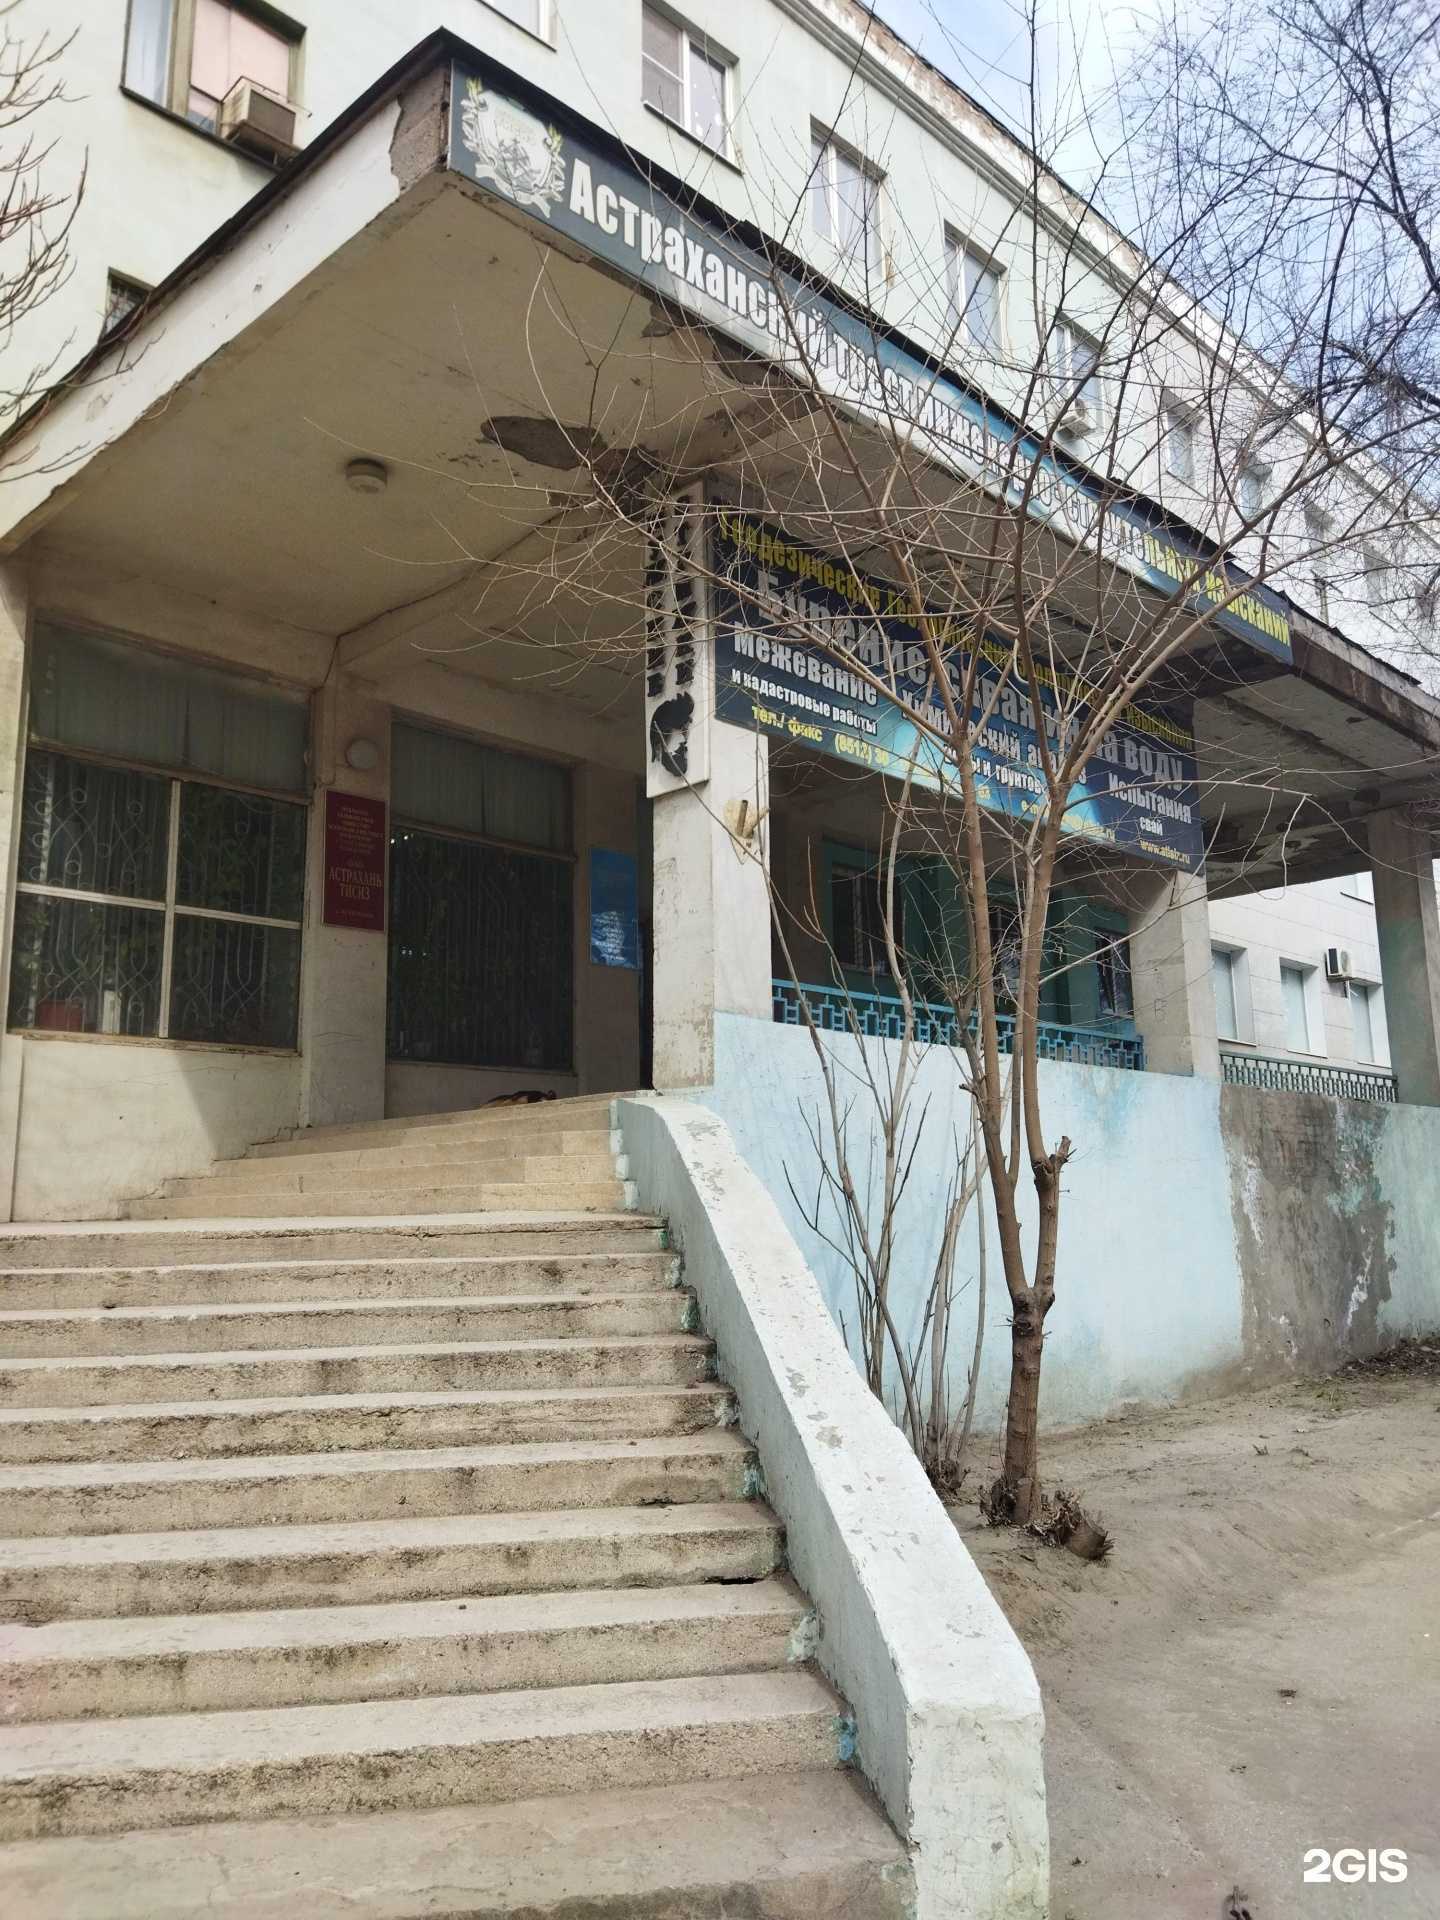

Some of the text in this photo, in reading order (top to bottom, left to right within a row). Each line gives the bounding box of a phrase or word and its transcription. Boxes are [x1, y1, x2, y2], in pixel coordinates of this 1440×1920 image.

[569, 158, 829, 368] Астраханский
[833, 332, 914, 414] трест
[734, 621, 878, 706] Межевание
[757, 571, 928, 686] Бурение
[943, 660, 1081, 745] сважин
[1124, 740, 1183, 791] воду
[743, 672, 831, 717] кадастровые
[832, 706, 877, 735] работы
[787, 717, 823, 742] факс
[902, 689, 1020, 761] Химиеский
[1109, 771, 1192, 824] Испытания
[1140, 816, 1163, 836] свай
